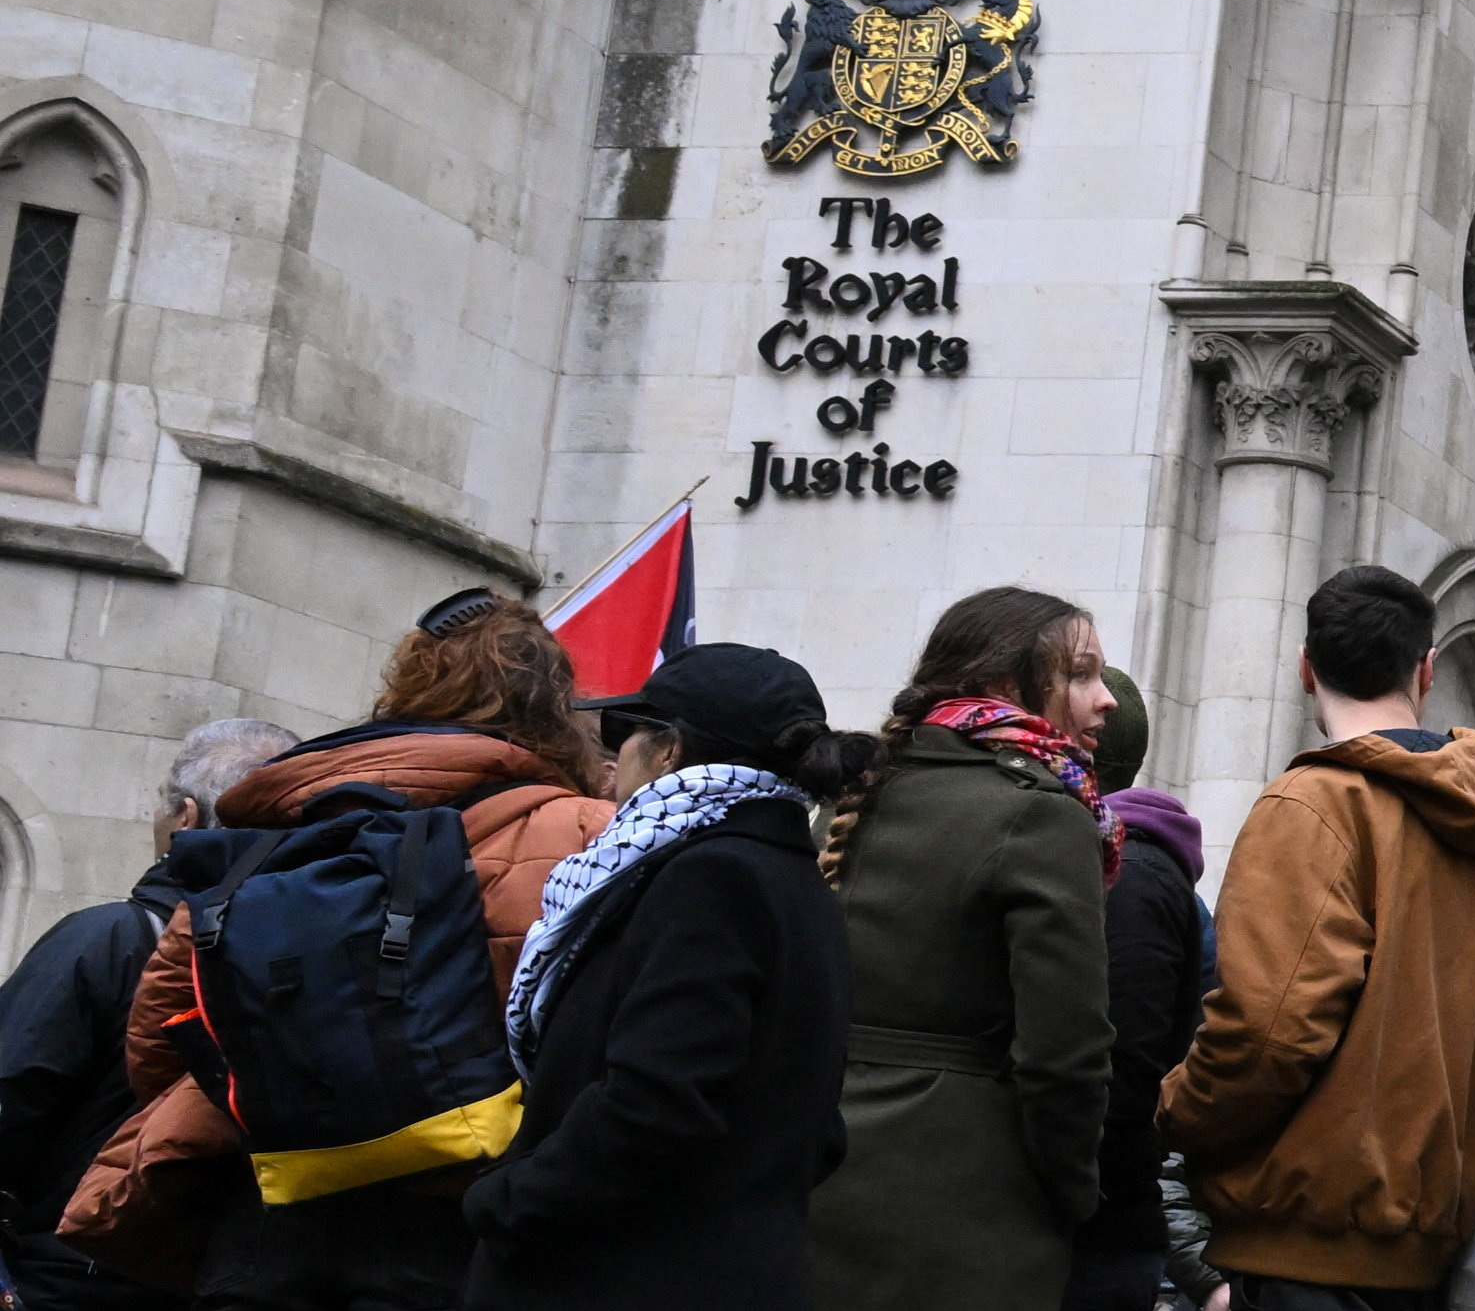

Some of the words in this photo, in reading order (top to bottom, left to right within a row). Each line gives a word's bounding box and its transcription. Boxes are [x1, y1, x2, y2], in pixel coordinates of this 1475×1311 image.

[936, 114, 991, 161] DROIT
[819, 197, 943, 250] The
[780, 256, 958, 321] Royal
[757, 319, 969, 373] Courts
[816, 377, 895, 432] of
[734, 440, 957, 509] Justice
